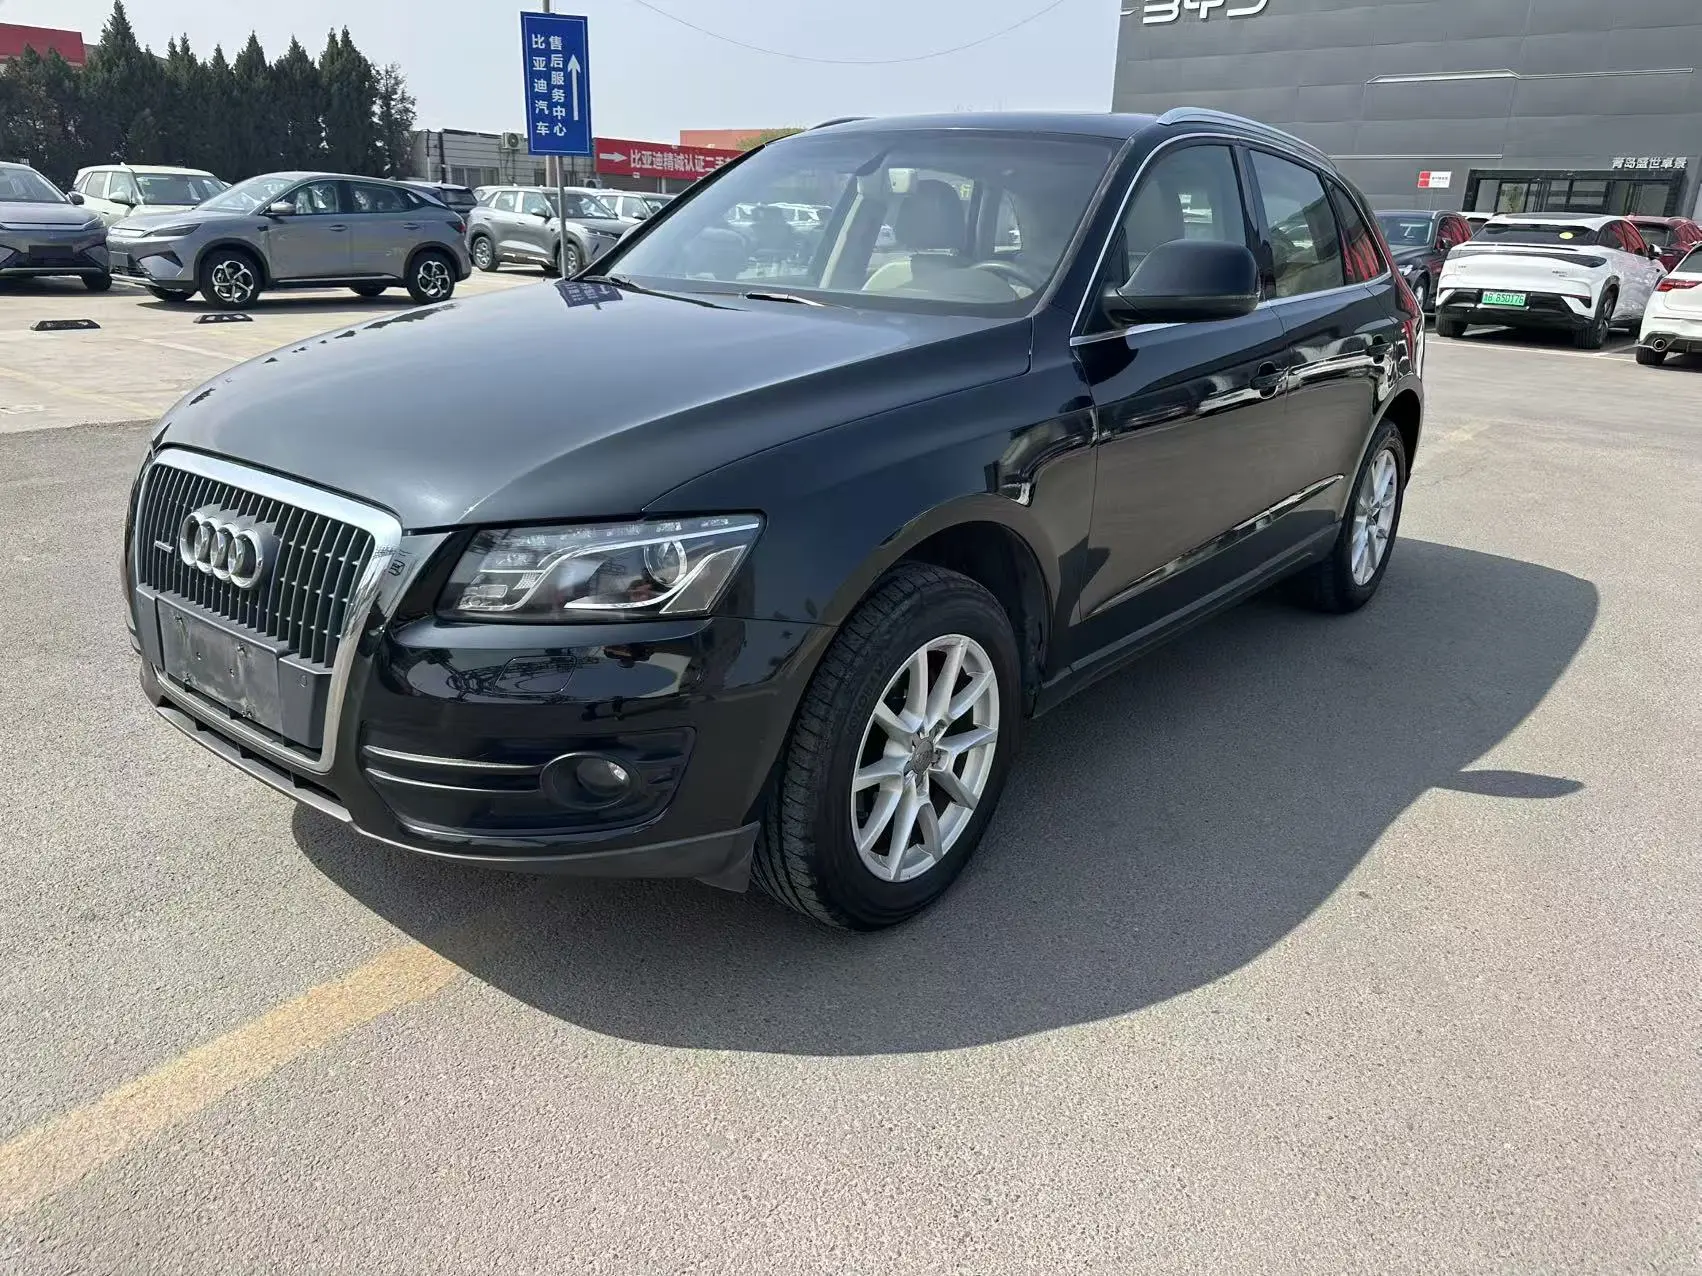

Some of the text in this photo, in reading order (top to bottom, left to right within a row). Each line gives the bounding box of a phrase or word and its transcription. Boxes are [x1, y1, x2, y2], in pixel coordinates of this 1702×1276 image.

[531, 33, 550, 136] 比亚迪汽车
[549, 35, 567, 136] 售后服务中心
[630, 149, 732, 172] 比亚迪精诚认证二手
